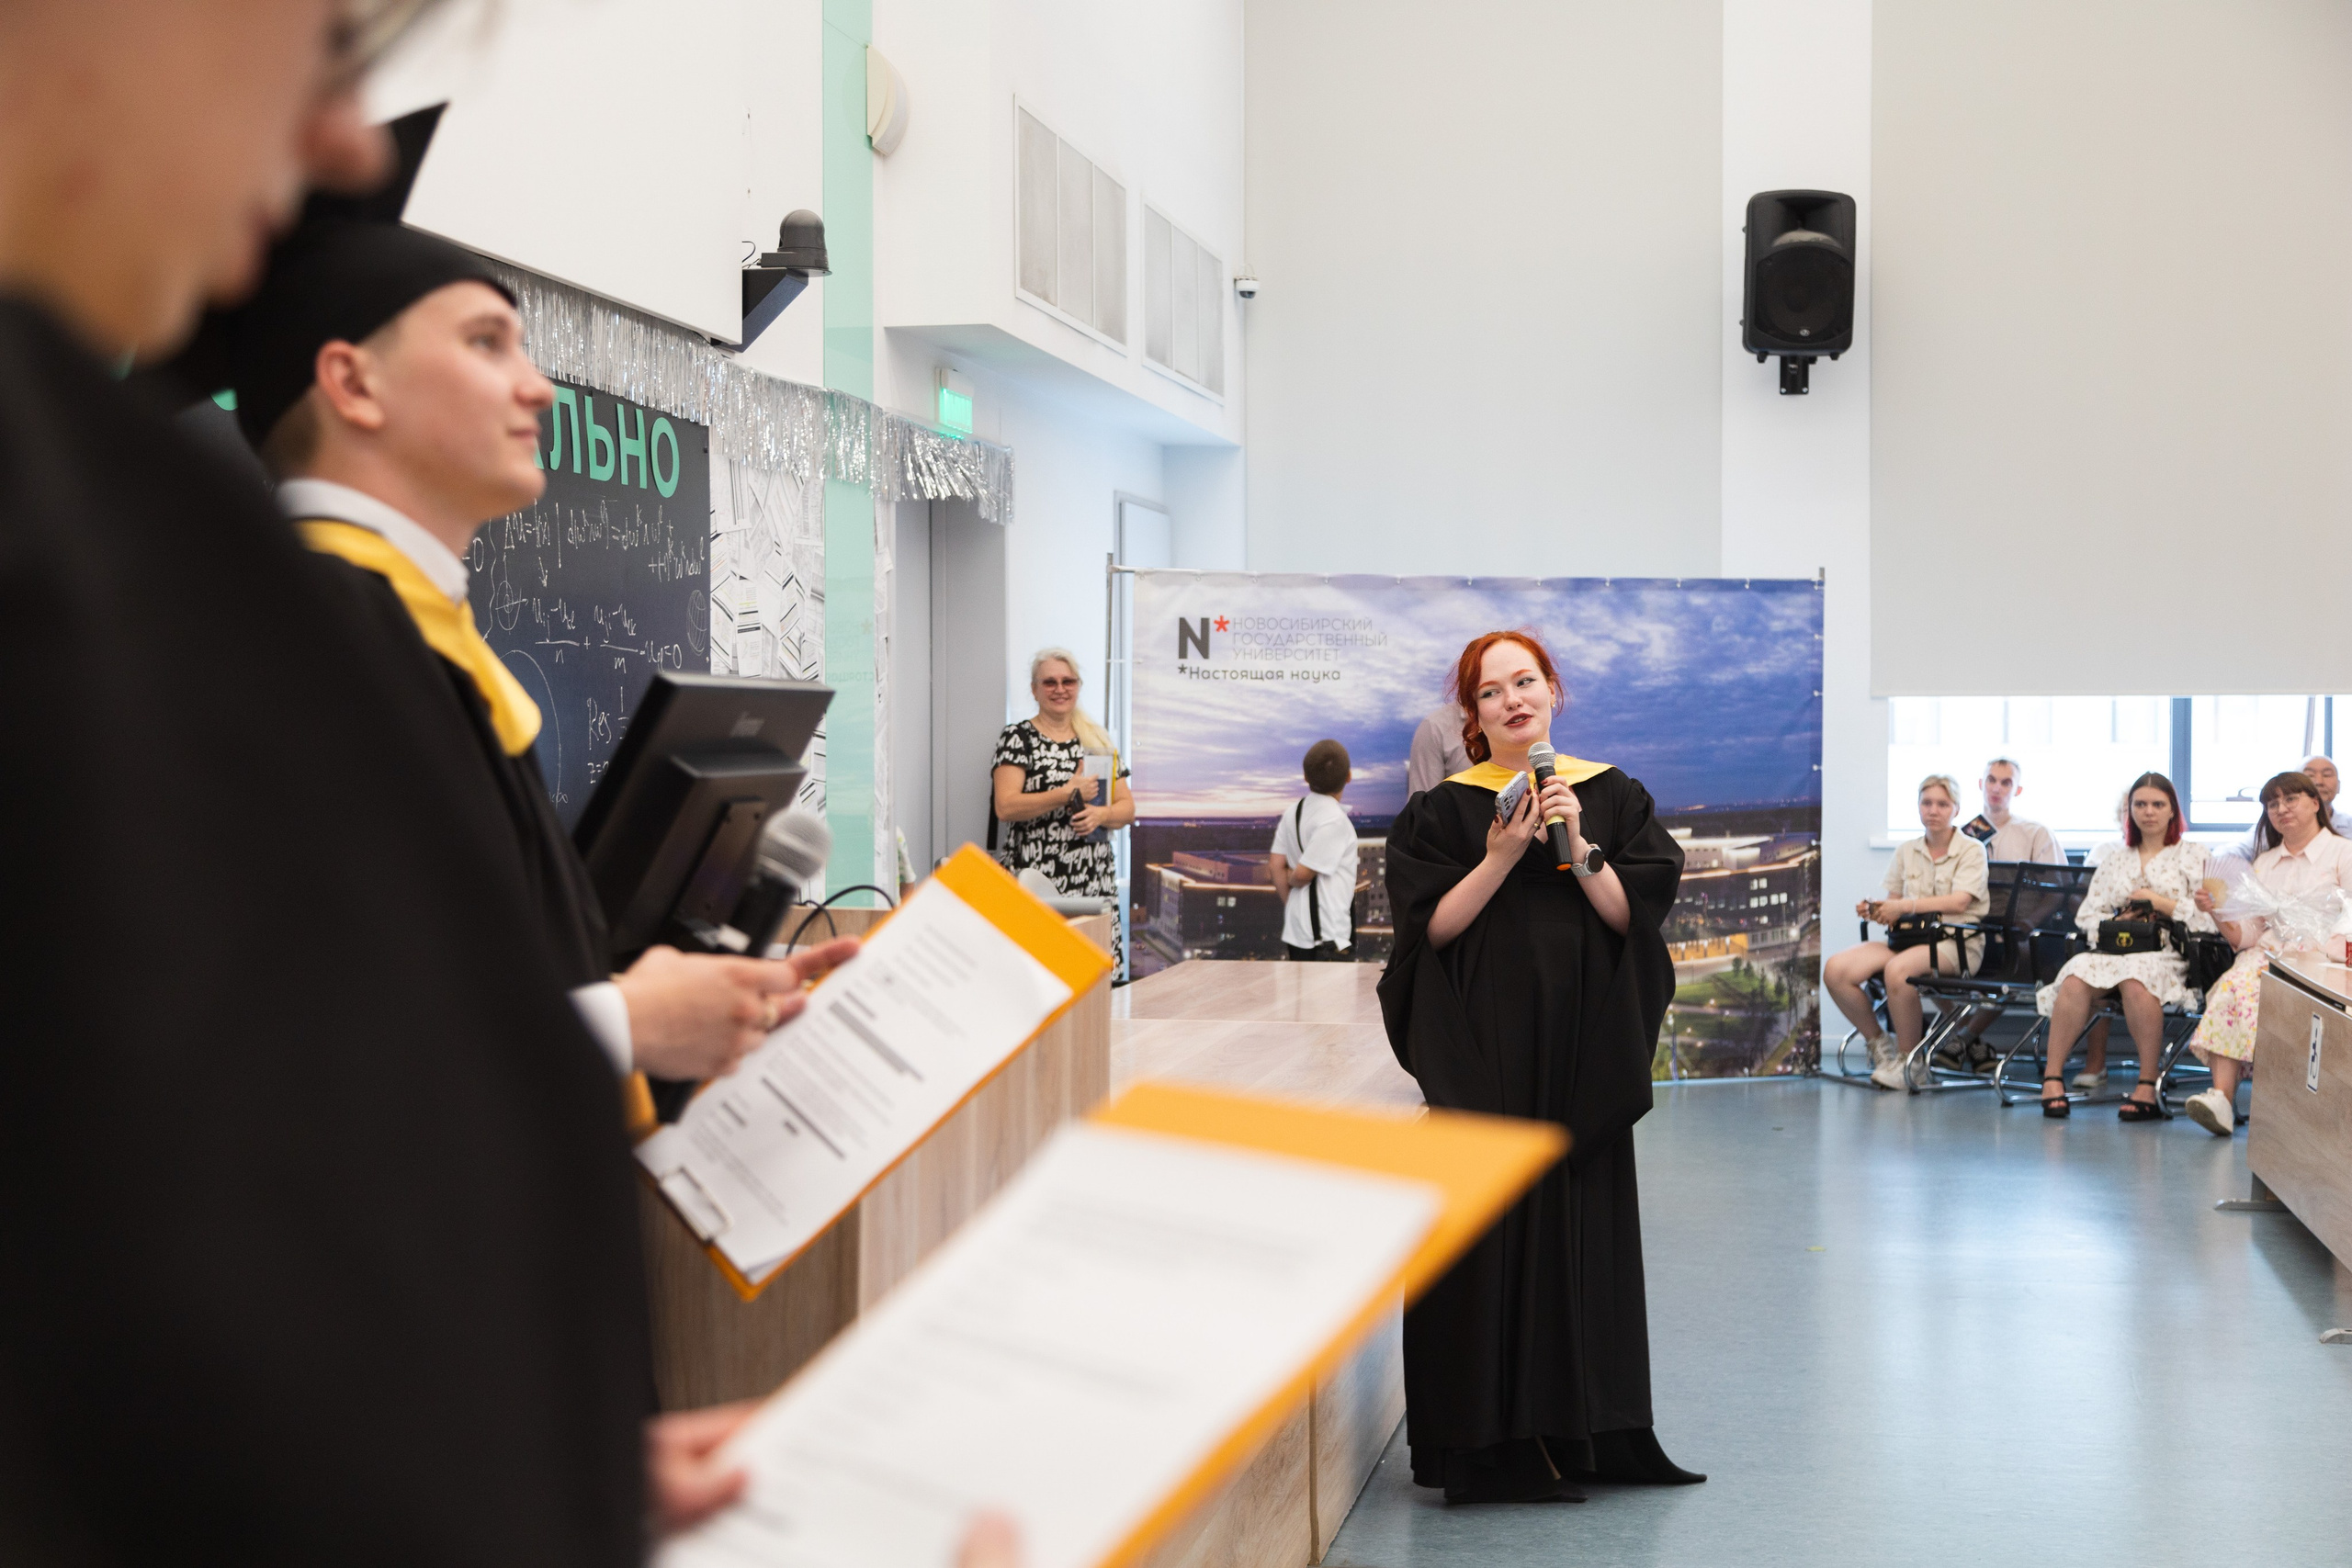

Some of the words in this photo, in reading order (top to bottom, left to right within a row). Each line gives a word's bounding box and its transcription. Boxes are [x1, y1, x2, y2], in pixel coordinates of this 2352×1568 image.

[534, 385, 680, 499] ЛЬНО
[1233, 615, 1373, 631] НОВОСИБИРСКИЙ
[1232, 632, 1388, 647] ГОСУДАРСТВЕННЫЙ
[1232, 648, 1340, 661] УНИВЕРСИТЕТ
[1291, 669, 1341, 683] наука
